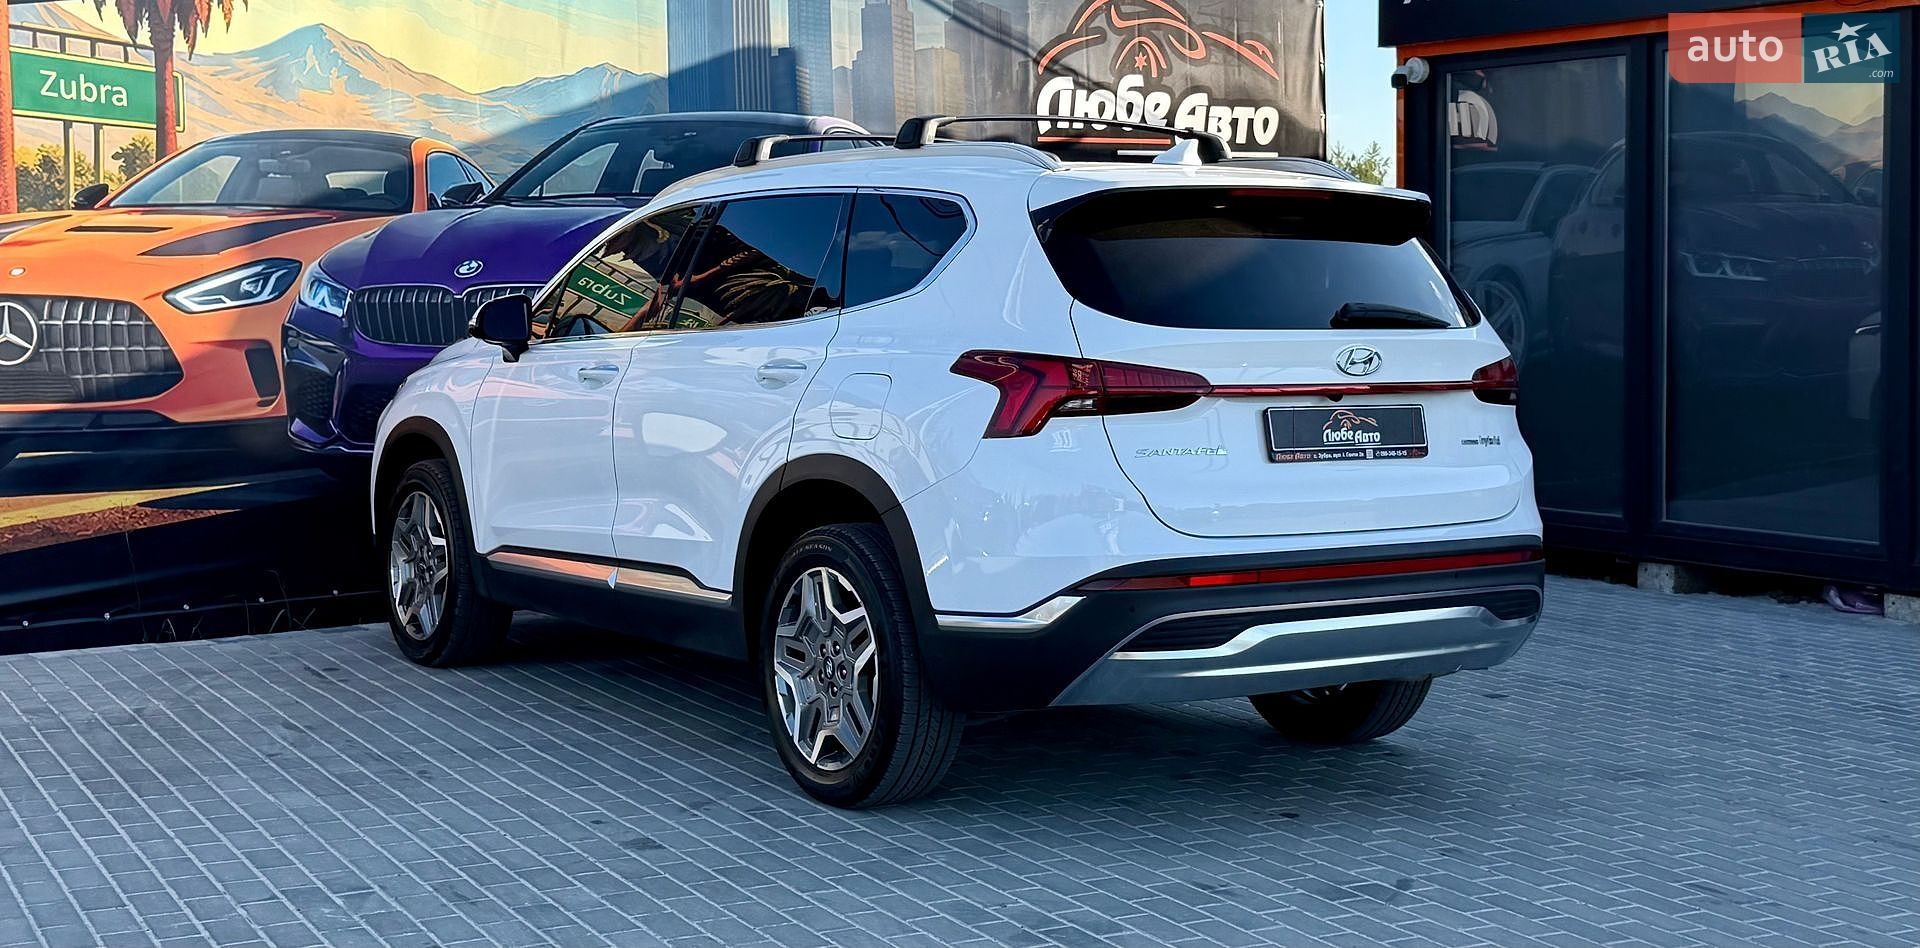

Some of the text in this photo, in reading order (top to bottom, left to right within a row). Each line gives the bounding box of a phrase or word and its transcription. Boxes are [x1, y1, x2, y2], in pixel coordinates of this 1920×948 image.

[39, 69, 128, 107] Zubra
[1036, 74, 1280, 146] Любе Авто
[1323, 427, 1381, 443] Любе Авто
